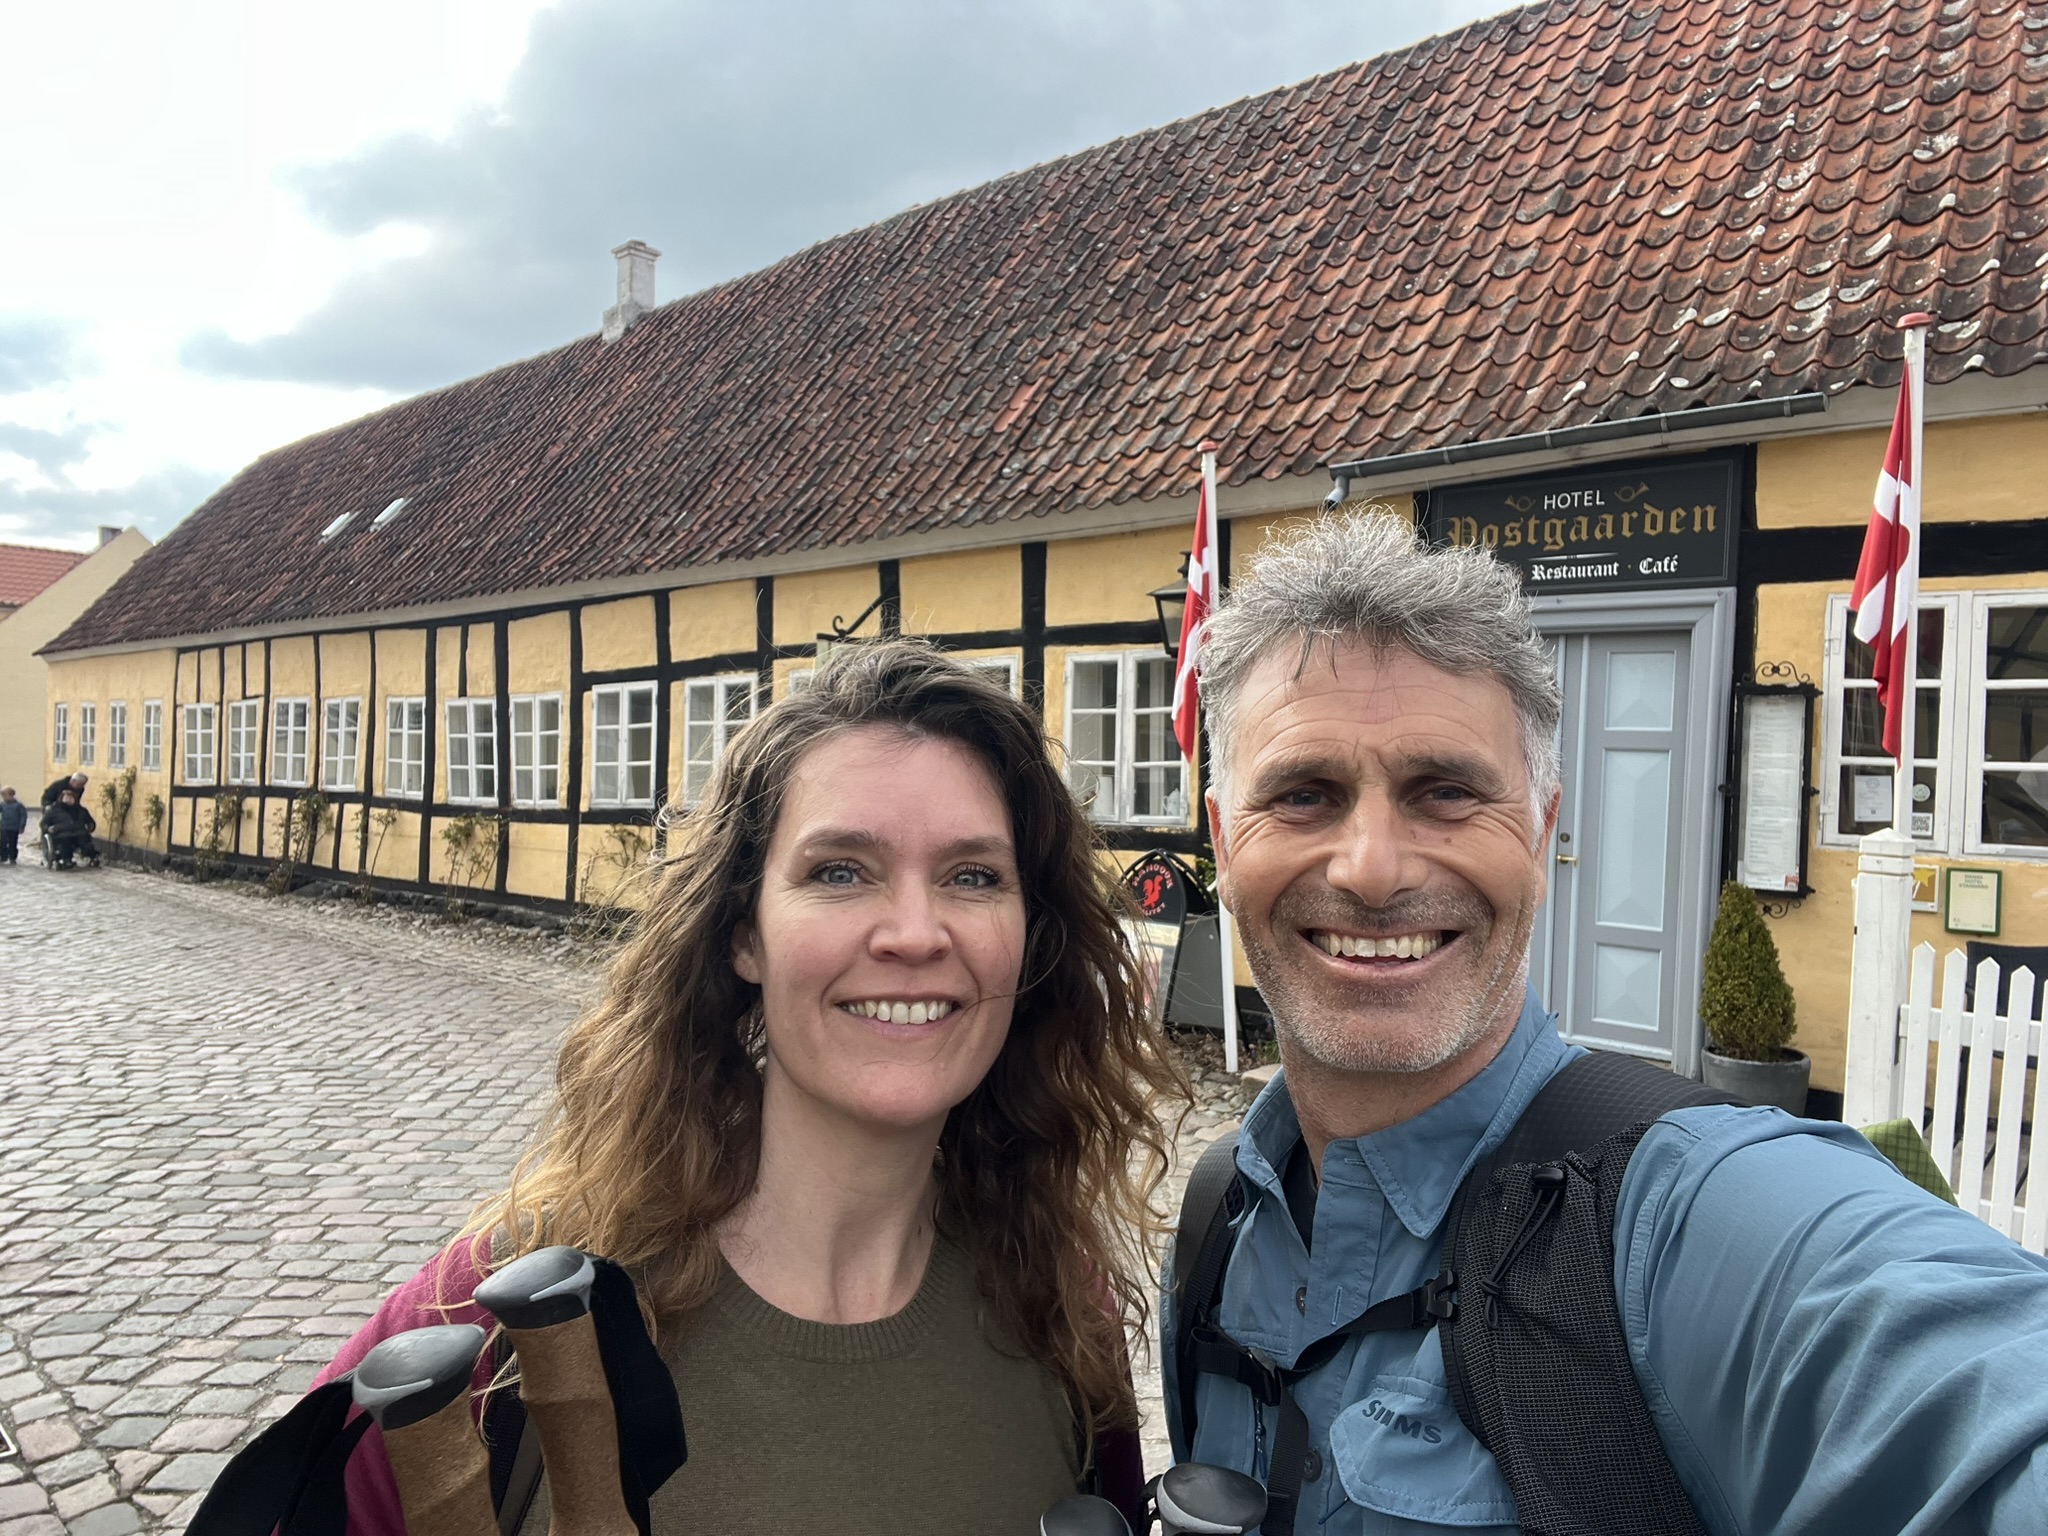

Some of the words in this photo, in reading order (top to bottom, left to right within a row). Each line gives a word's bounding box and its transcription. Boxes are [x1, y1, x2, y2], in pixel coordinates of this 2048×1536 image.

[1543, 489, 1605, 511] HOTEL
[1446, 502, 1718, 552] Postgaarden
[1530, 561, 1620, 581] Restaurant
[1638, 554, 1679, 575] Café
[1362, 1399, 1442, 1445] SIMMS
